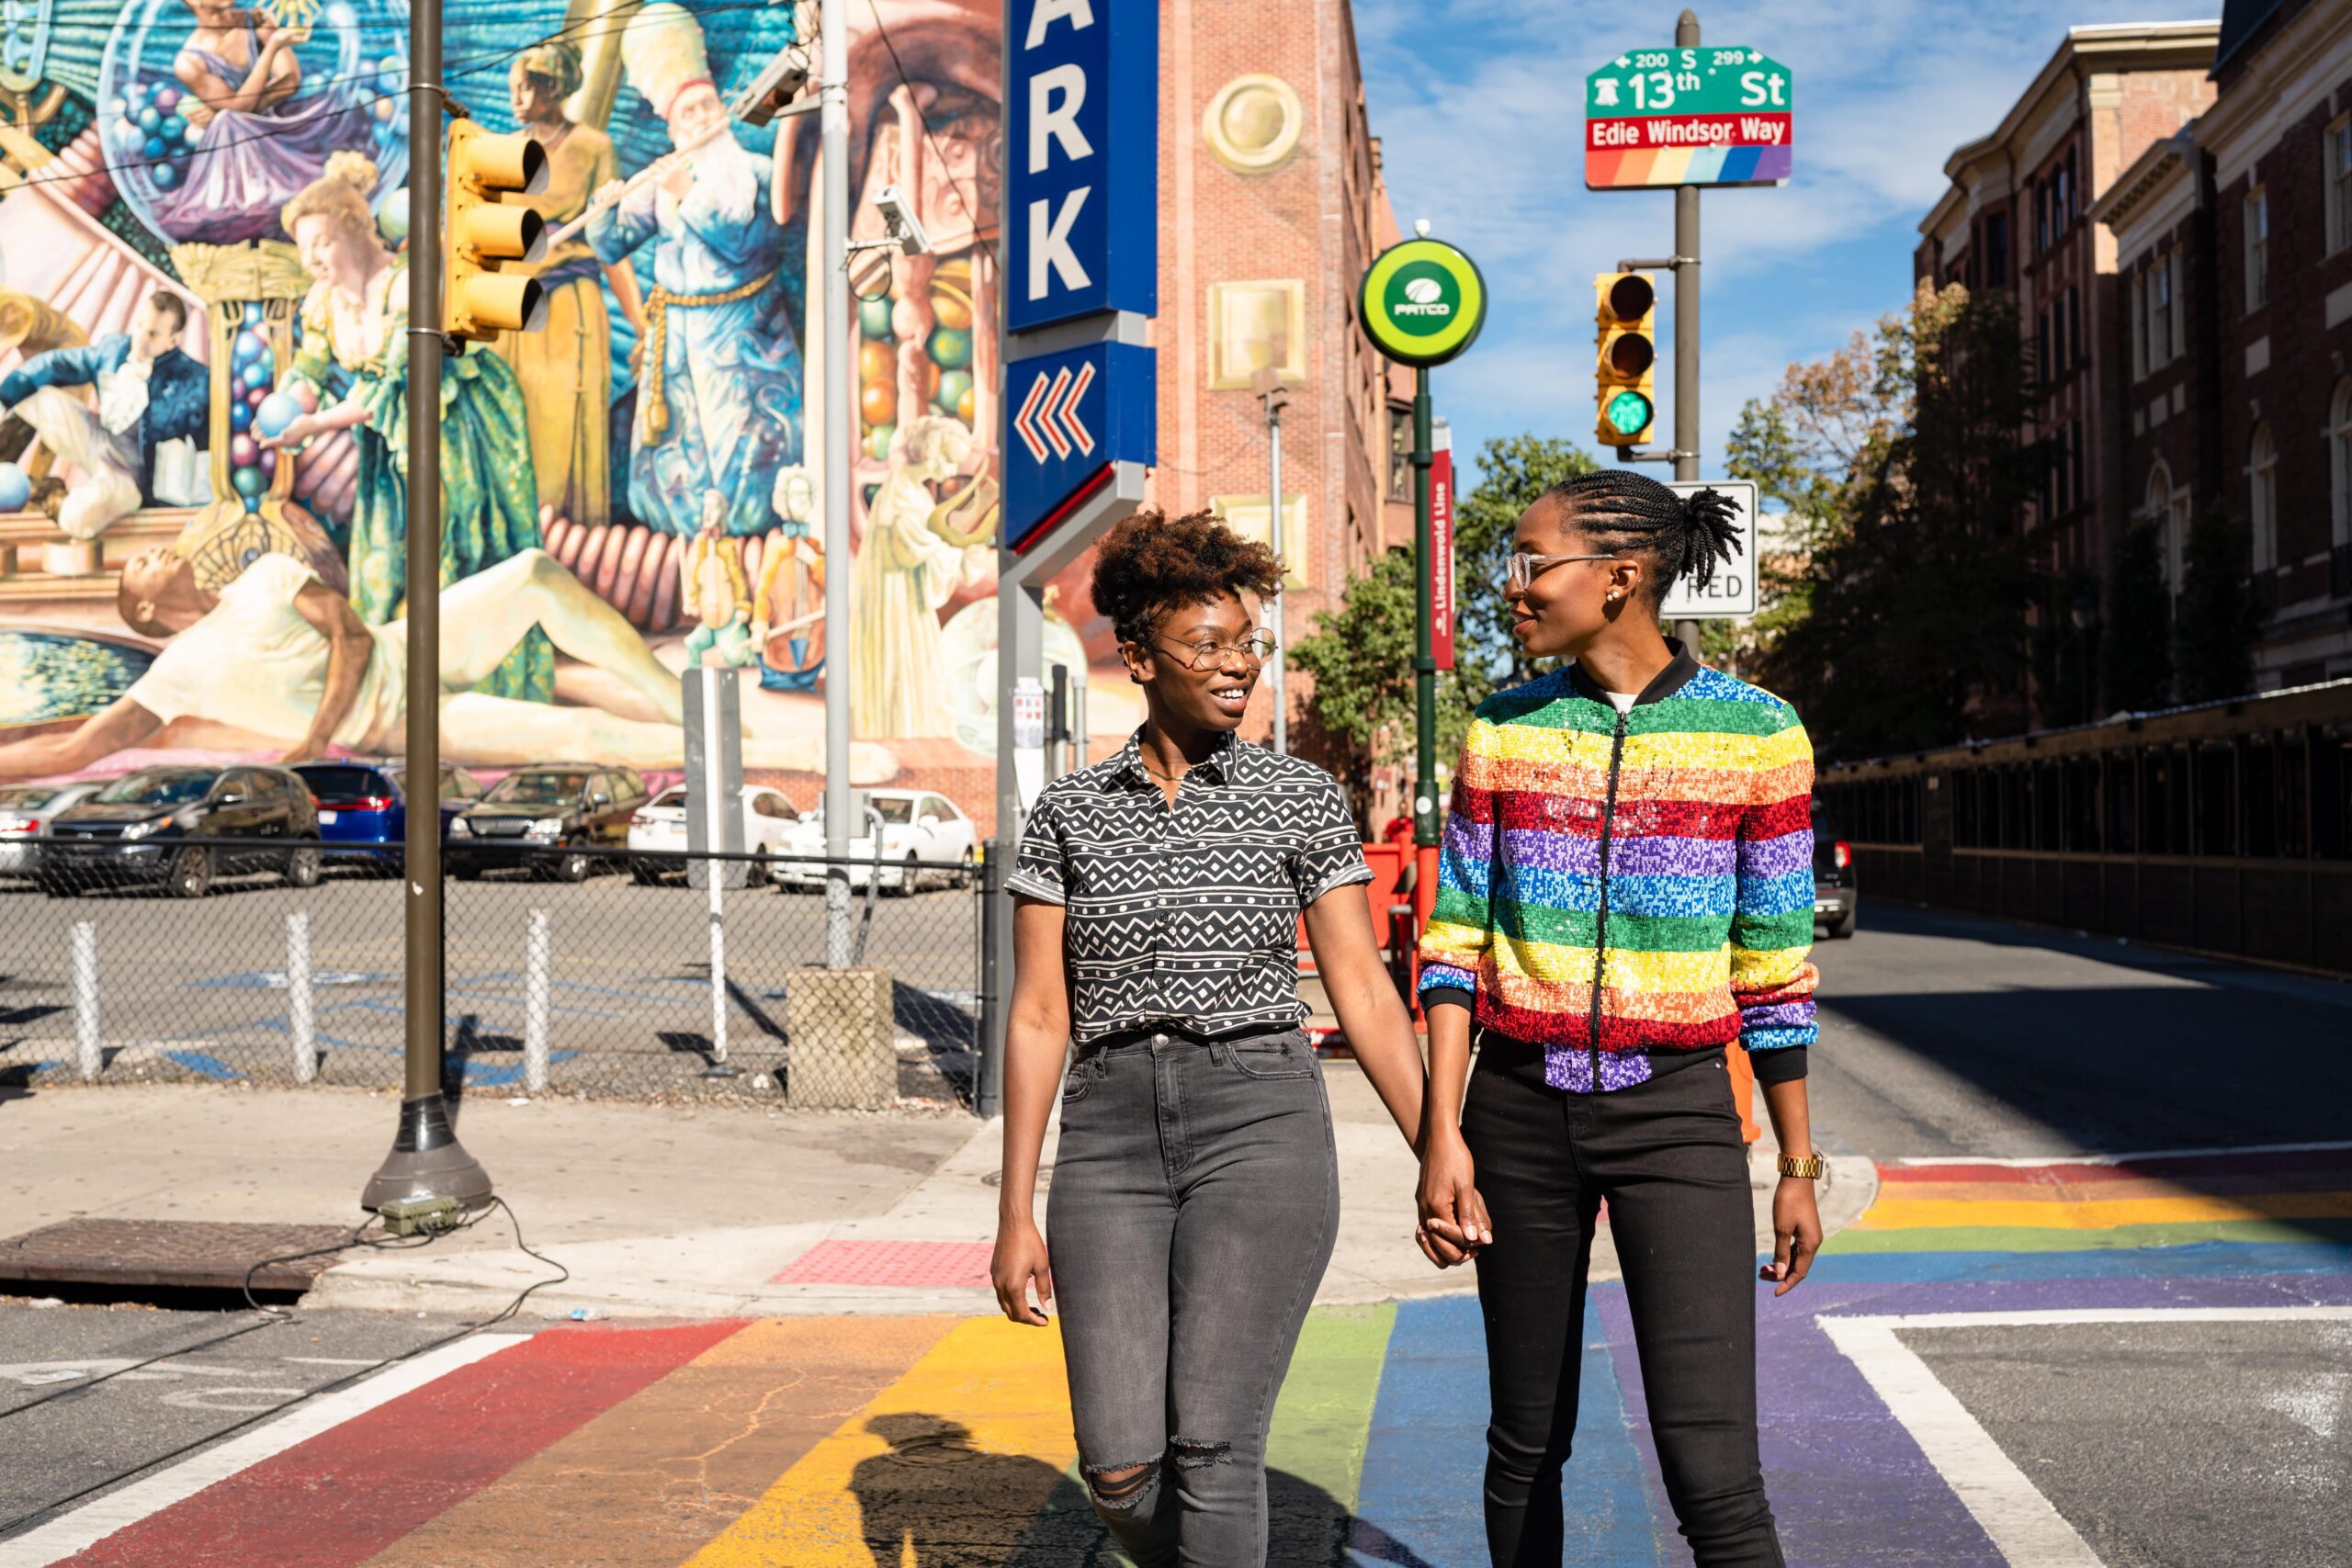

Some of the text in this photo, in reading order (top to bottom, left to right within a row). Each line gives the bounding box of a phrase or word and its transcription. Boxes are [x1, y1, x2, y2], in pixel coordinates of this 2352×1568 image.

[1635, 50, 1745, 70] 200 S 299
[1629, 71, 1785, 110] 13th St
[1592, 118, 1785, 146] Edie Windsor Way
[1394, 303, 1450, 316] PATCO
[1434, 481, 1447, 516] Line
[1434, 518, 1447, 610] Lindenwold
